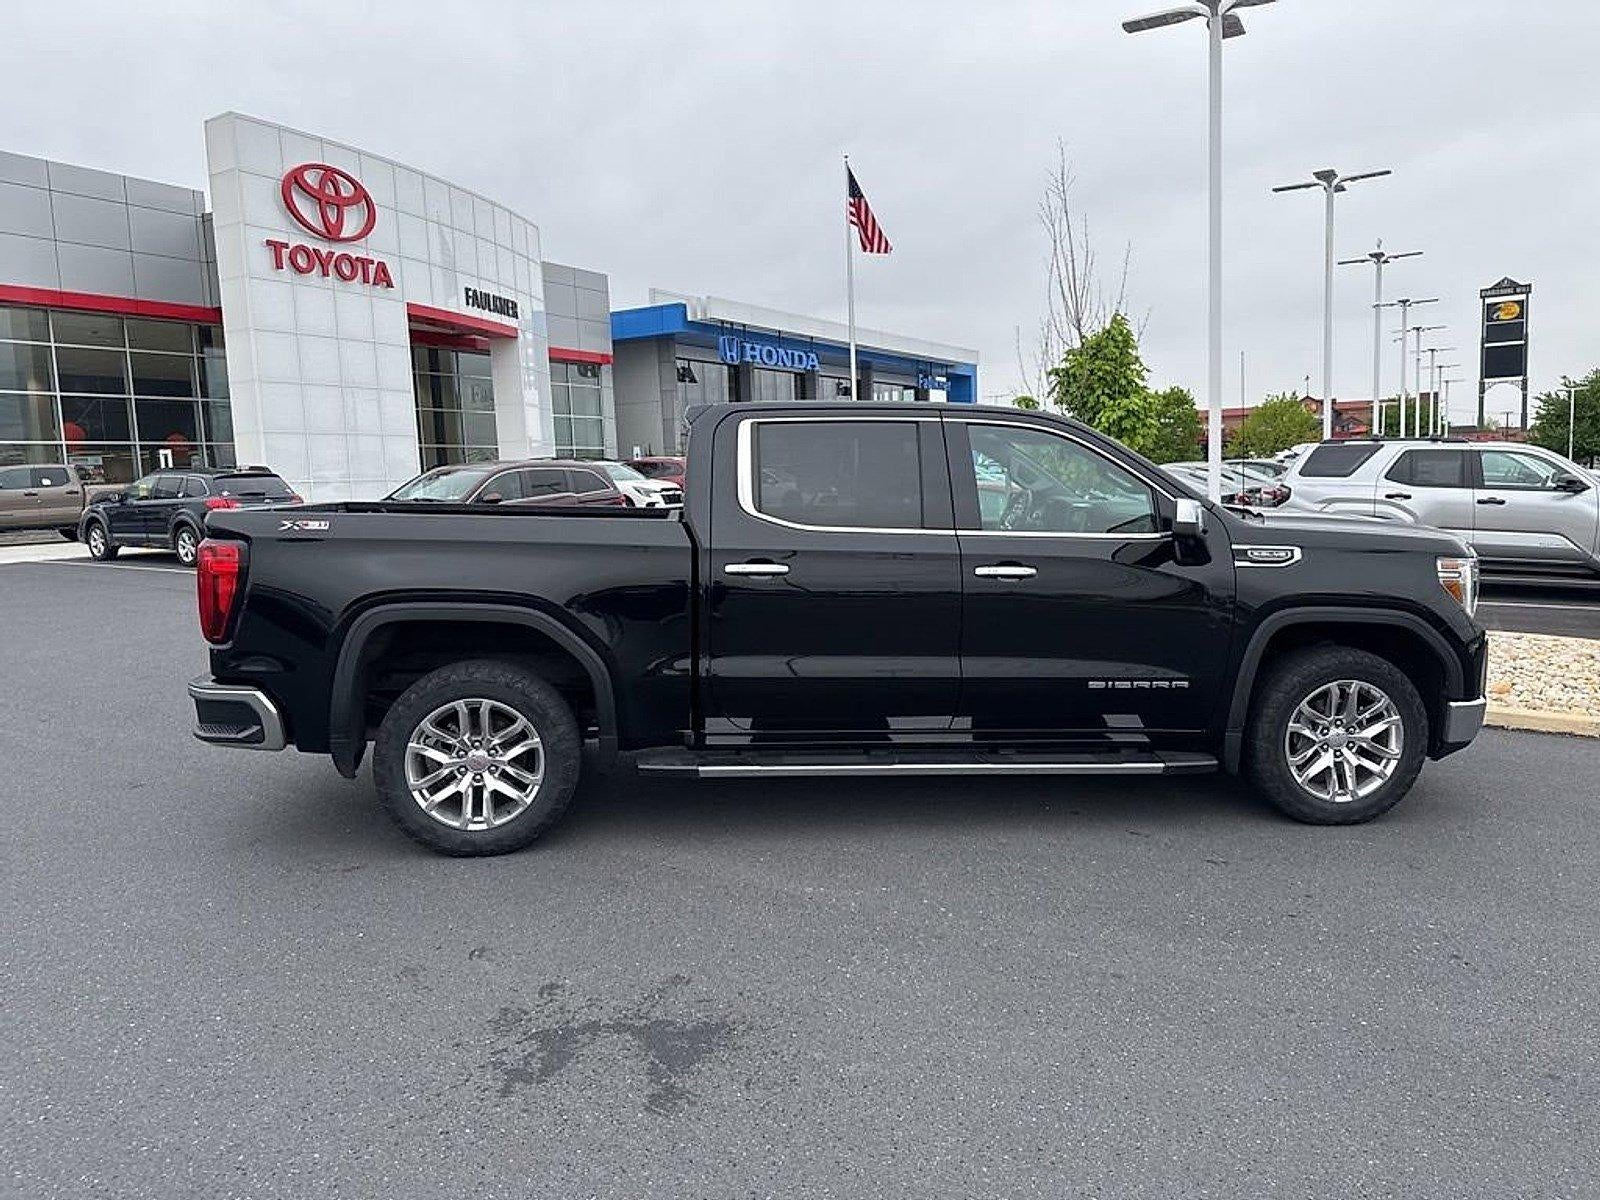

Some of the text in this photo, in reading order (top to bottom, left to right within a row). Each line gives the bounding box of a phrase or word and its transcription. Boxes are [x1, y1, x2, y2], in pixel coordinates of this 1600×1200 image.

[265, 239, 395, 289] TOYOTA
[464, 287, 519, 320] FAULKNER
[742, 342, 820, 370] HONDA
